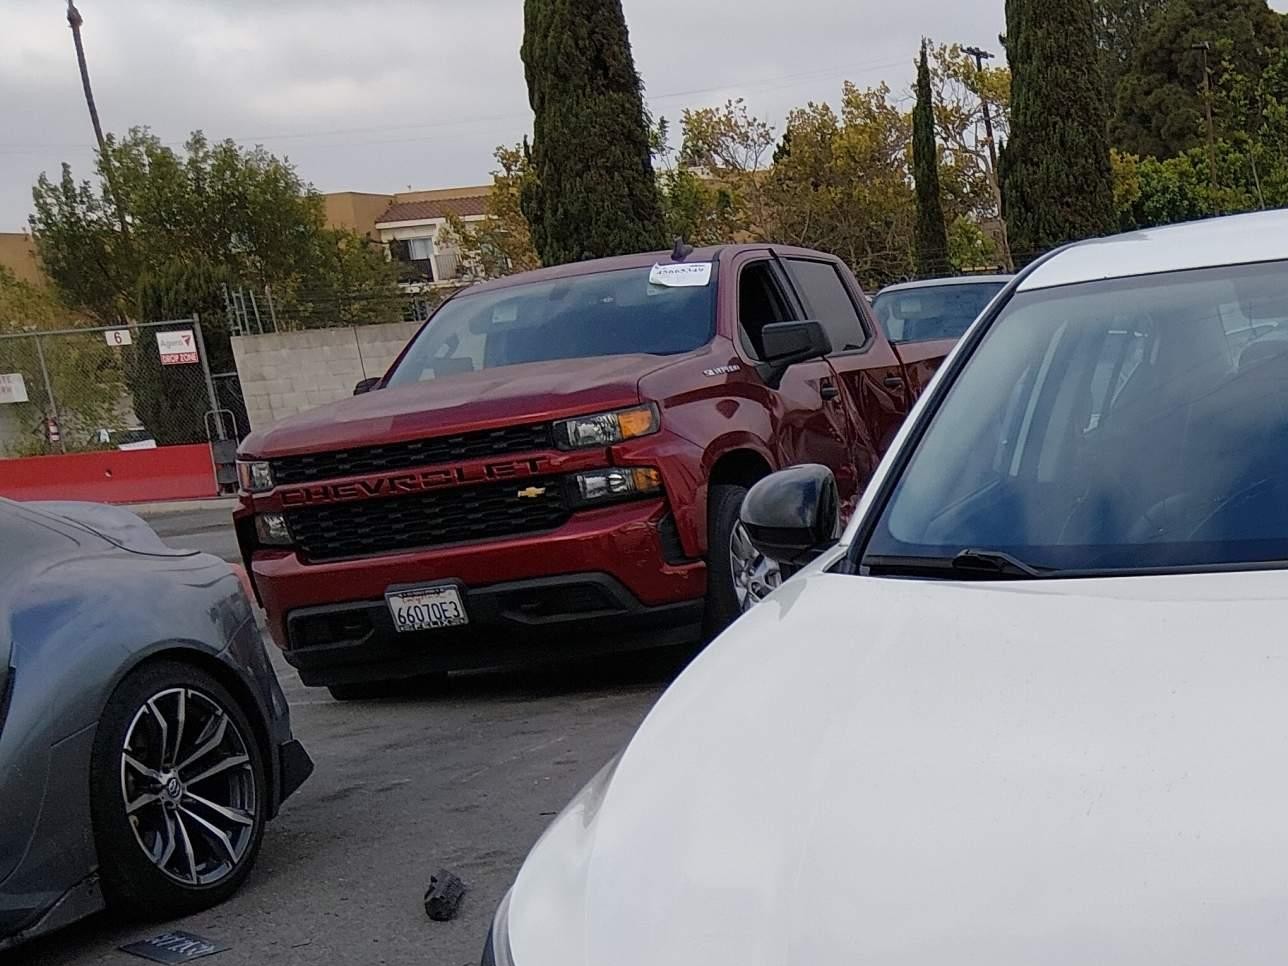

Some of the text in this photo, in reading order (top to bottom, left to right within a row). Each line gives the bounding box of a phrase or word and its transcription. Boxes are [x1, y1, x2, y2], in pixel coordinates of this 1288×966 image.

[113, 331, 123, 345] 6
[161, 352, 198, 363] DROP ZONE
[279, 456, 550, 507] CHEVROLET
[397, 601, 460, 625] 66070E3
